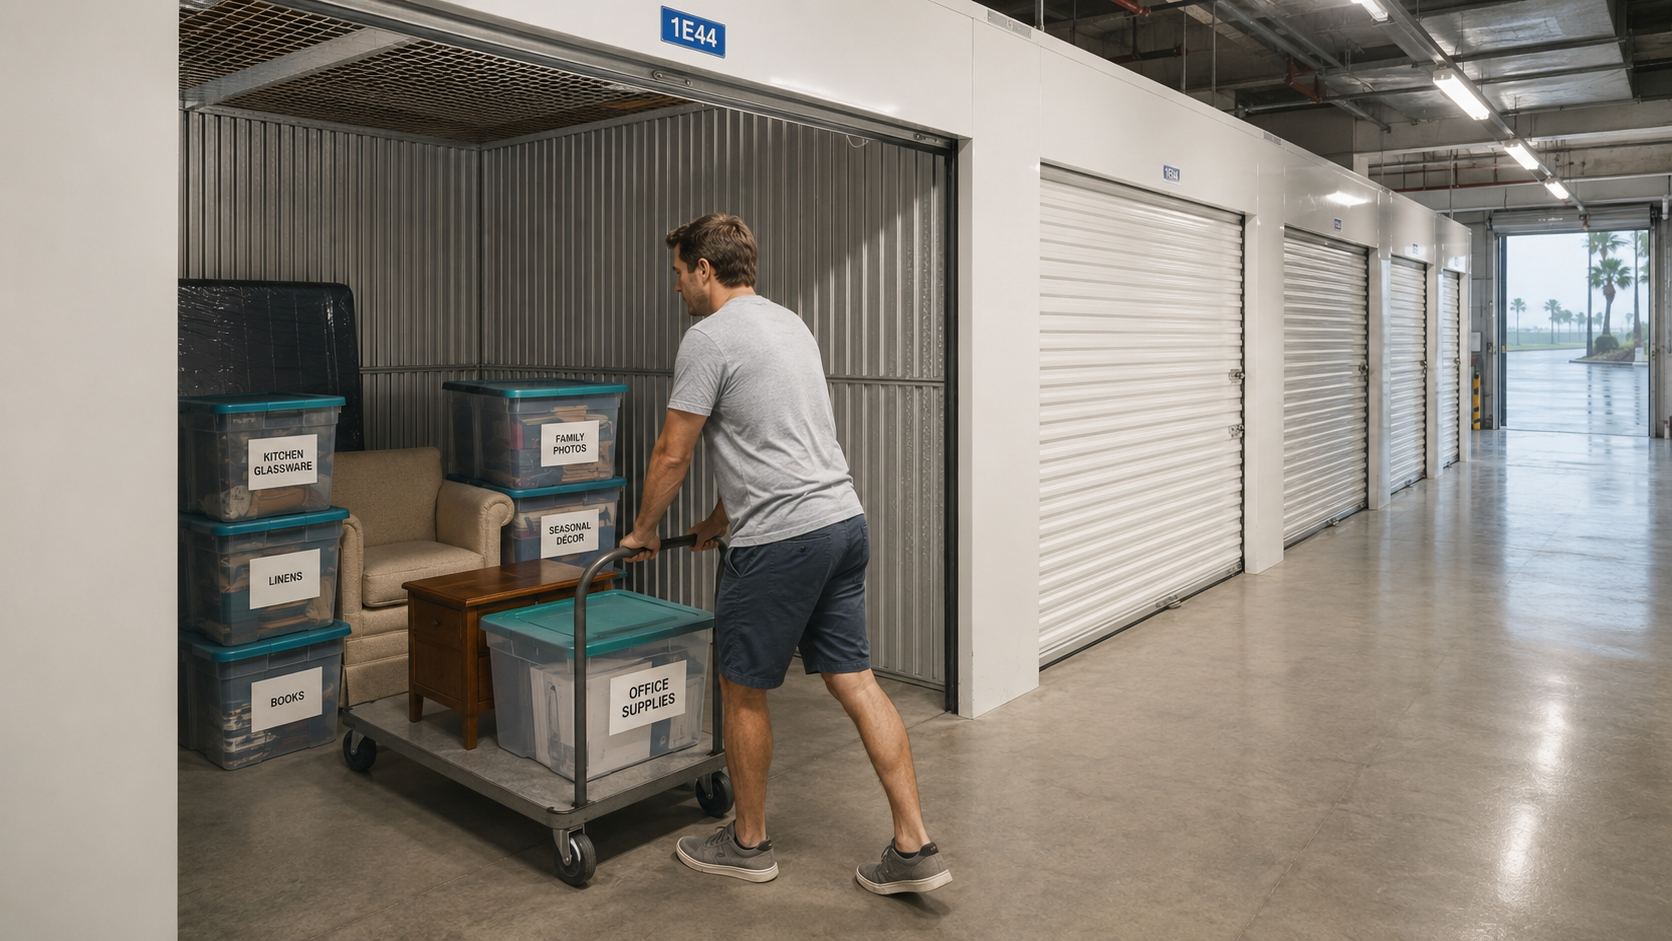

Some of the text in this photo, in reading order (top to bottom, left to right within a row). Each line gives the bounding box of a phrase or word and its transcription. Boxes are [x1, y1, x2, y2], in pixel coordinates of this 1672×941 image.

[671, 16, 718, 48] 1E44
[555, 432, 585, 443] FAMILY
[263, 449, 304, 462] KITCHEN
[553, 443, 587, 455] PHOTOS
[254, 461, 313, 476] GLASSWARE
[549, 521, 592, 535] SEASONAL
[556, 533, 585, 545] DÉCOR
[268, 571, 303, 586] LINENS
[629, 677, 669, 699] OFFICE
[270, 690, 305, 708] BOOKS
[622, 692, 676, 718] SUPPLIES
